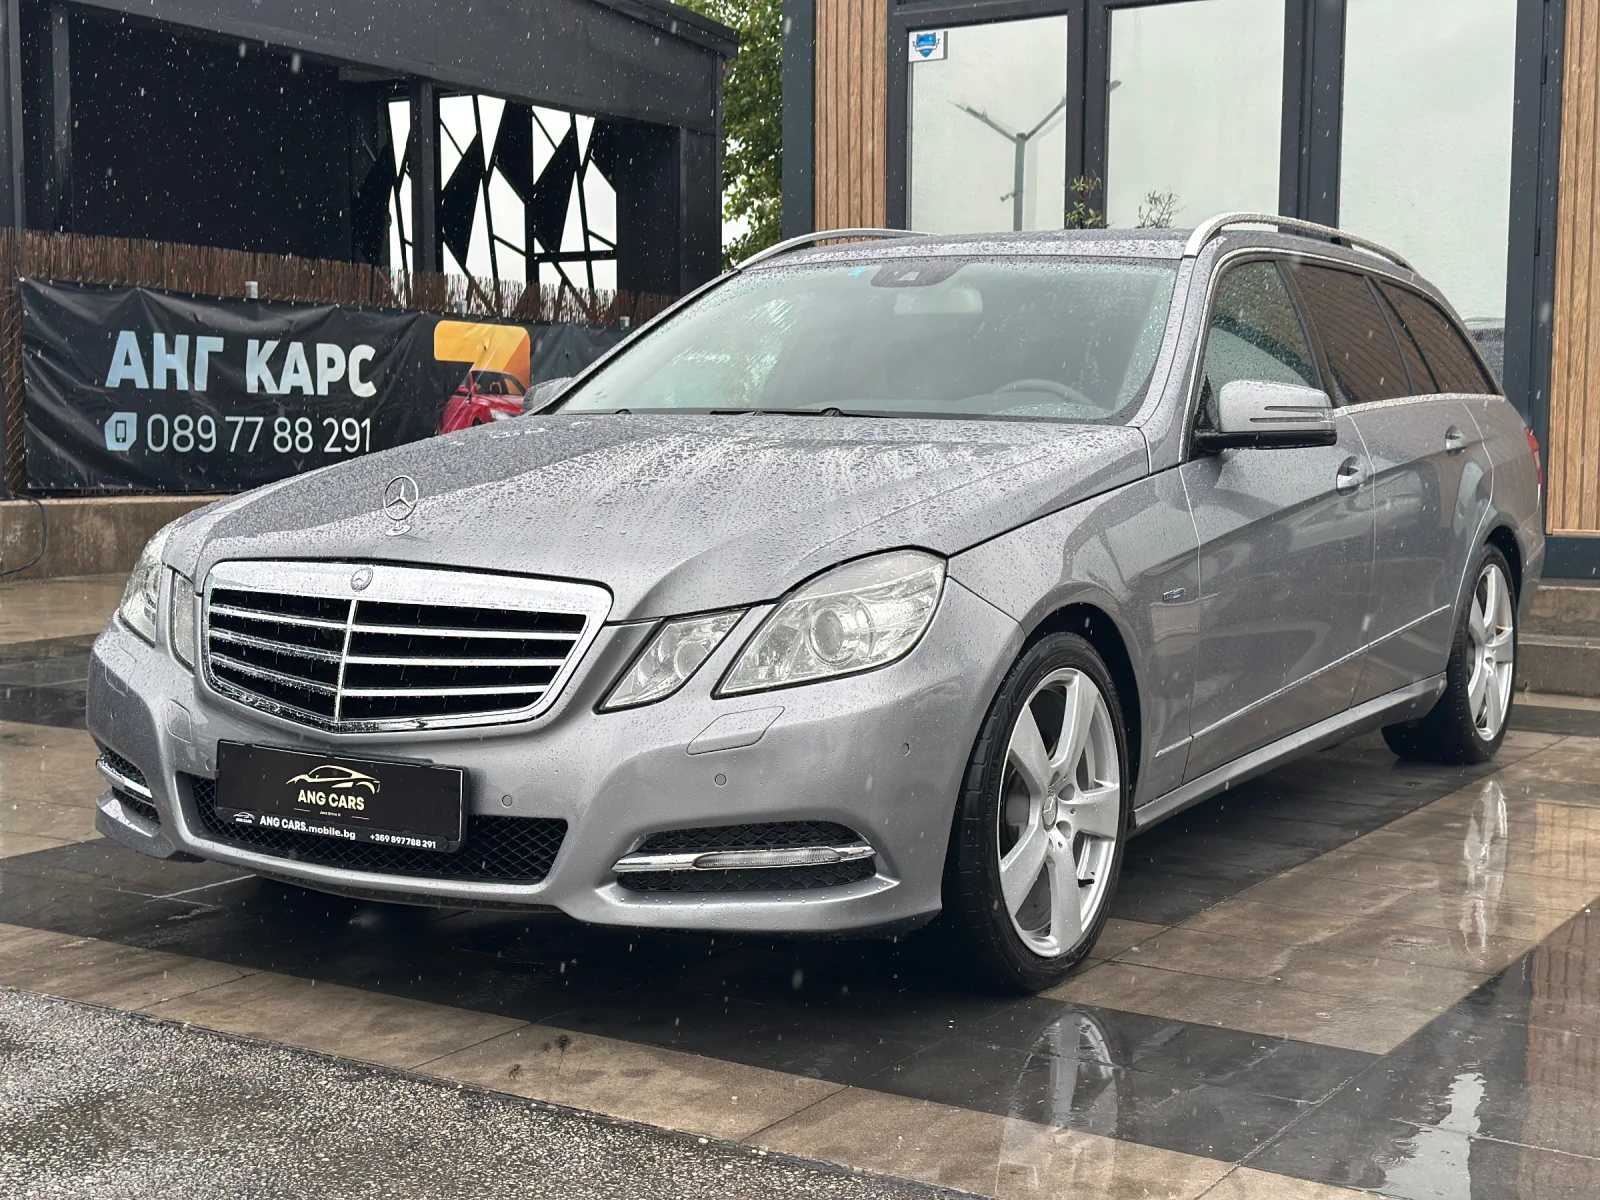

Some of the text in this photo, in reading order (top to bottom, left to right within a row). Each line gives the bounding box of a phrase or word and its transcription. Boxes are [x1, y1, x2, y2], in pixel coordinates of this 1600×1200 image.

[105, 330, 377, 398] АНГ КАРС
[147, 413, 371, 453] 089 77 88 291
[297, 789, 365, 811] ANG CARS
[259, 815, 356, 840] ANG CARS.mobile.bg
[370, 833, 390, 843] +359
[422, 840, 436, 849] 291
